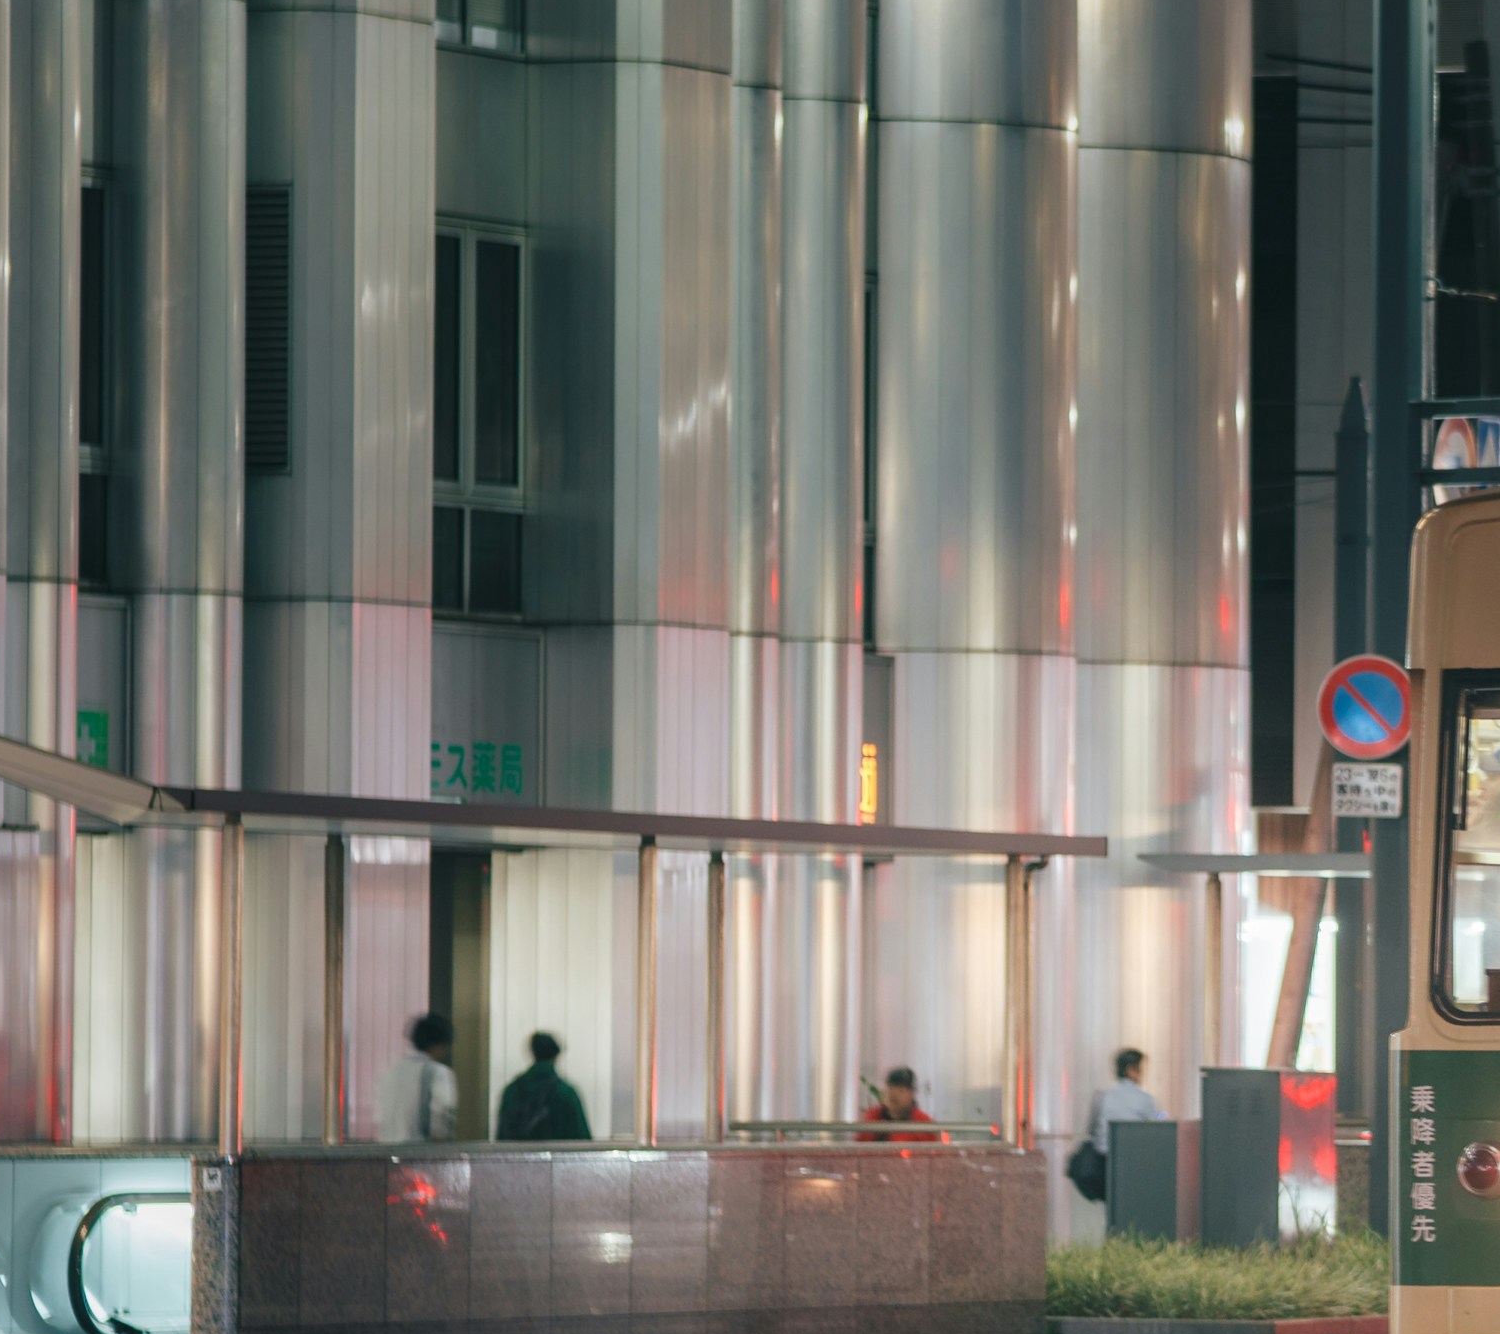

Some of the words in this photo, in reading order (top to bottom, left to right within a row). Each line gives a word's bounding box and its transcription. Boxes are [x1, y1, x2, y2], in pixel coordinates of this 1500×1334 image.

[1410, 1085, 1437, 1243] 乗降者優先
